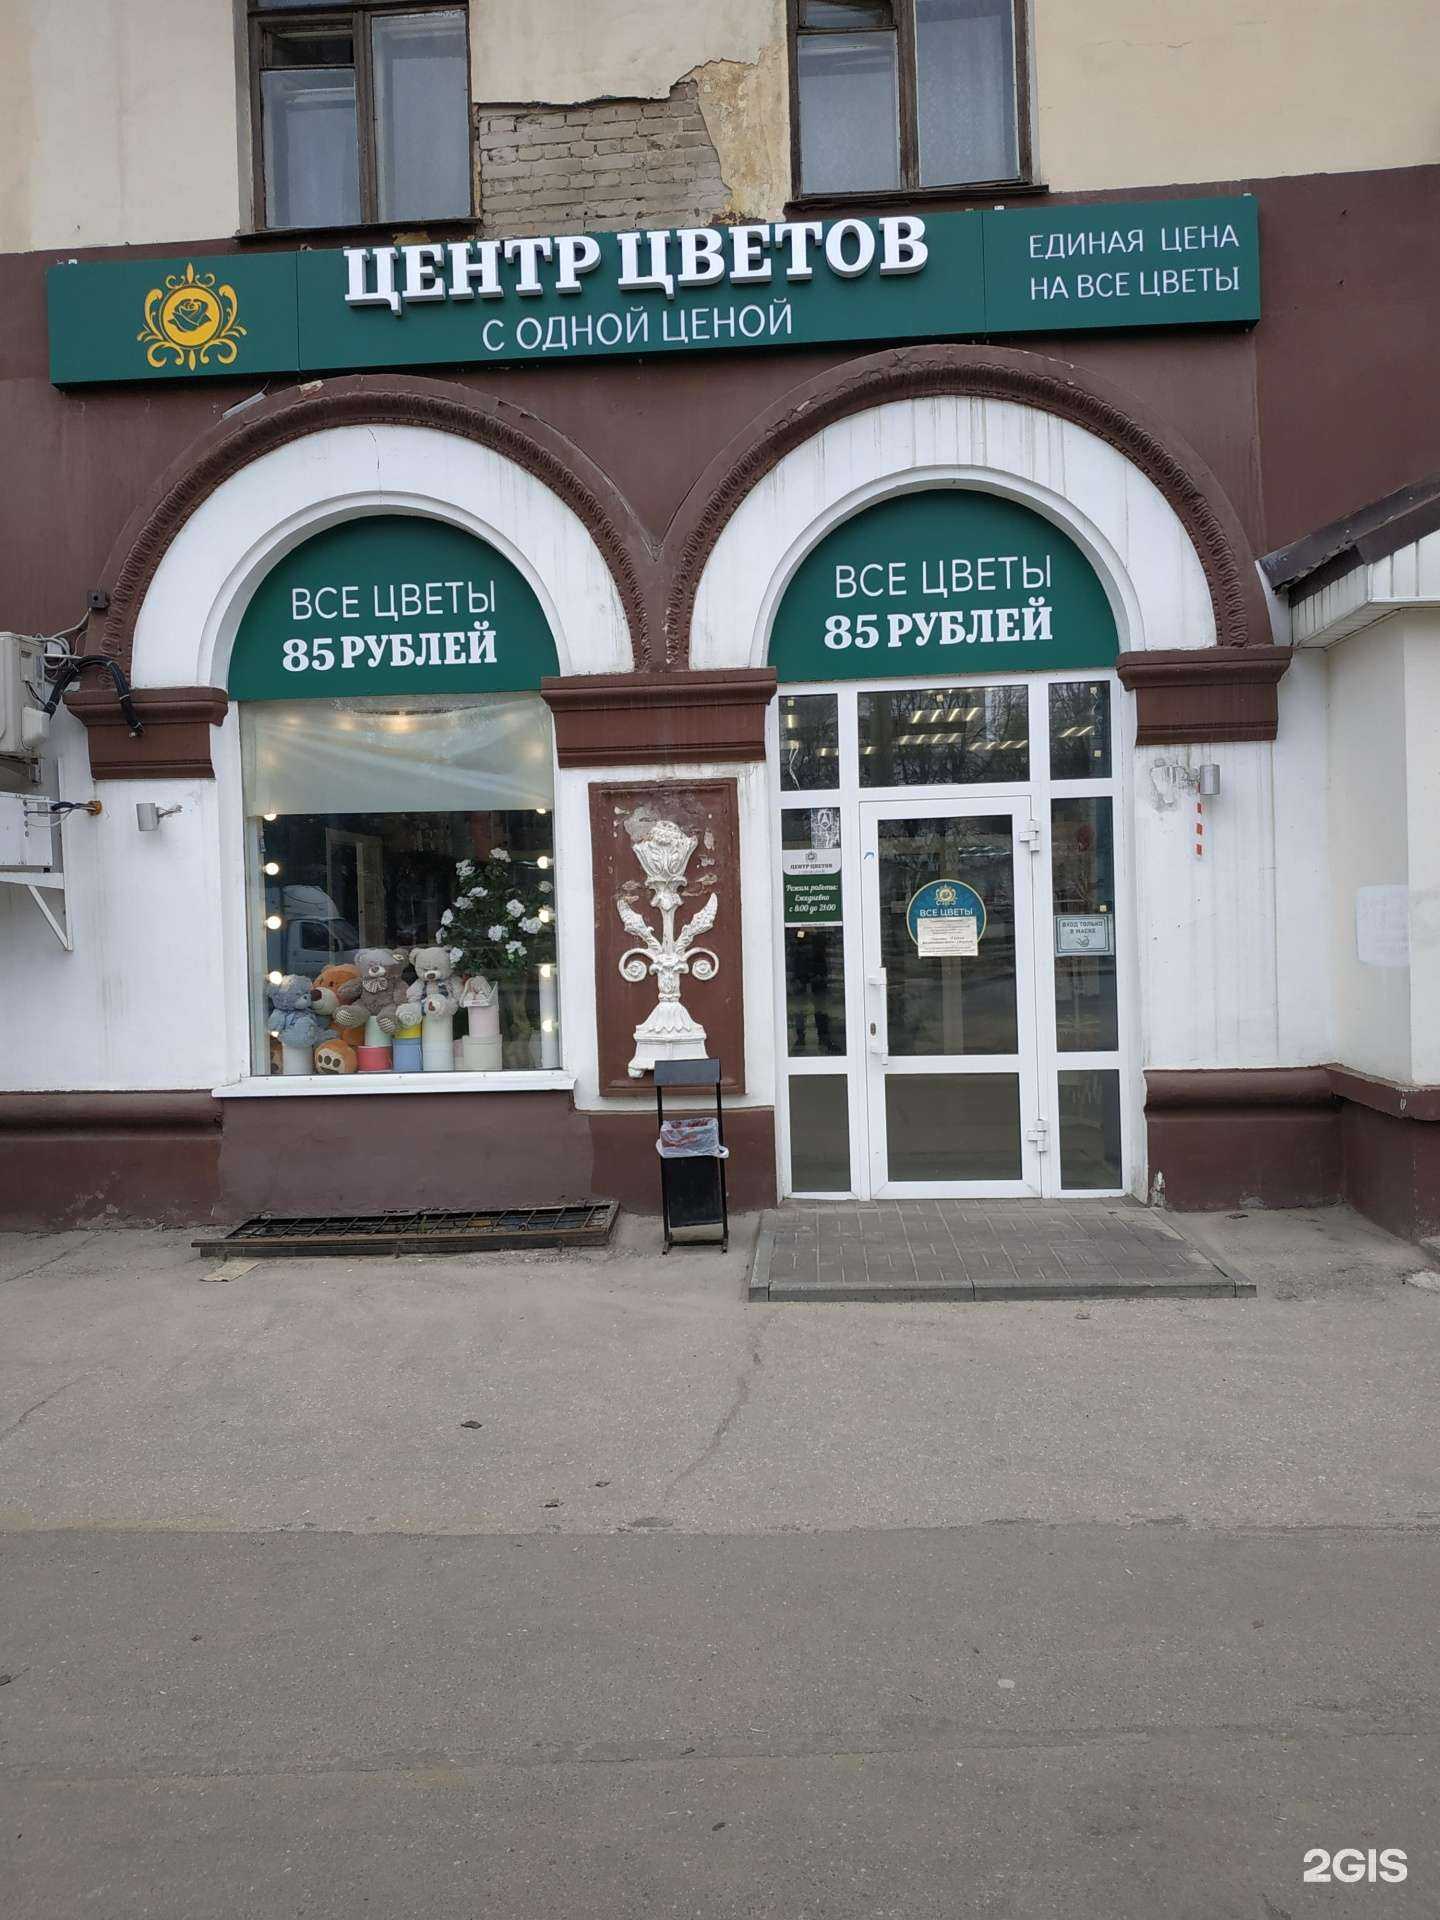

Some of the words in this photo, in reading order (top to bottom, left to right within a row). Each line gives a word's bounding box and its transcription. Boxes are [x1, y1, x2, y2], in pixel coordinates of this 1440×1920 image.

[1029, 229, 1144, 260] ЕДИНАЯ
[1161, 224, 1240, 253] ЦЕНА
[343, 235, 601, 317] ЦЕНТР
[616, 215, 929, 301] ЦВЕТОВ
[1030, 276, 1070, 301] НА
[1076, 272, 1131, 299] ВСЕ
[1139, 266, 1240, 297] ЦВЕТЫ
[482, 319, 506, 352] С
[515, 305, 649, 351] ОДНОЙ
[662, 297, 793, 345] ЦЕНОЙ
[834, 561, 908, 599] ВСЕ
[921, 554, 1052, 599] ЦВЕТЫ
[291, 585, 360, 621] ВСЕ
[373, 579, 496, 622] ЦВЕТЫ
[823, 614, 880, 650] 85
[886, 596, 1054, 648] РУБЛЕЙ
[282, 637, 336, 673] 85
[340, 620, 498, 669] РУБЛЕЙ
[920, 909, 939, 917] ВСЕ
[940, 907, 973, 917] ЦВЕТЫ
